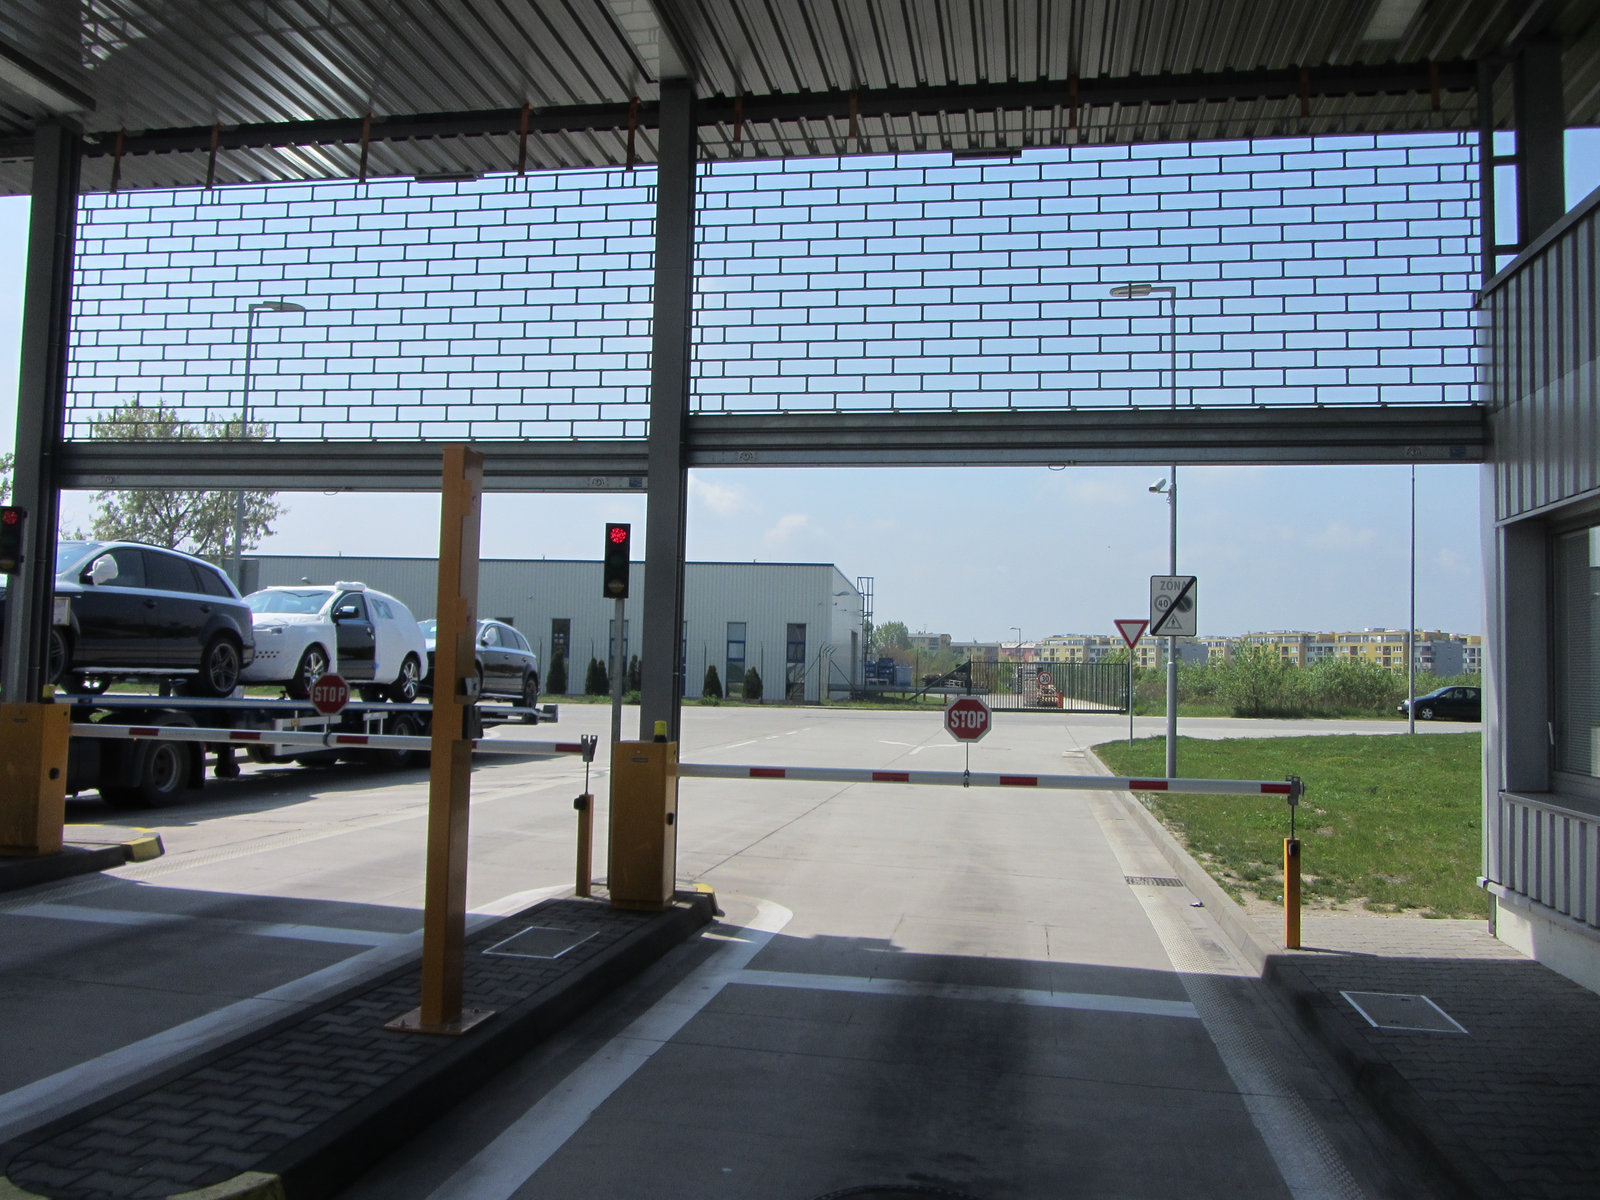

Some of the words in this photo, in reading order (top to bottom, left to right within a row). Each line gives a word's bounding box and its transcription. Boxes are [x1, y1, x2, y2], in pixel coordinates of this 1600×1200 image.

[1158, 599, 1169, 608] 40
[1041, 675, 1050, 683] 30
[314, 686, 346, 702] STOP
[950, 709, 986, 729] STOP
